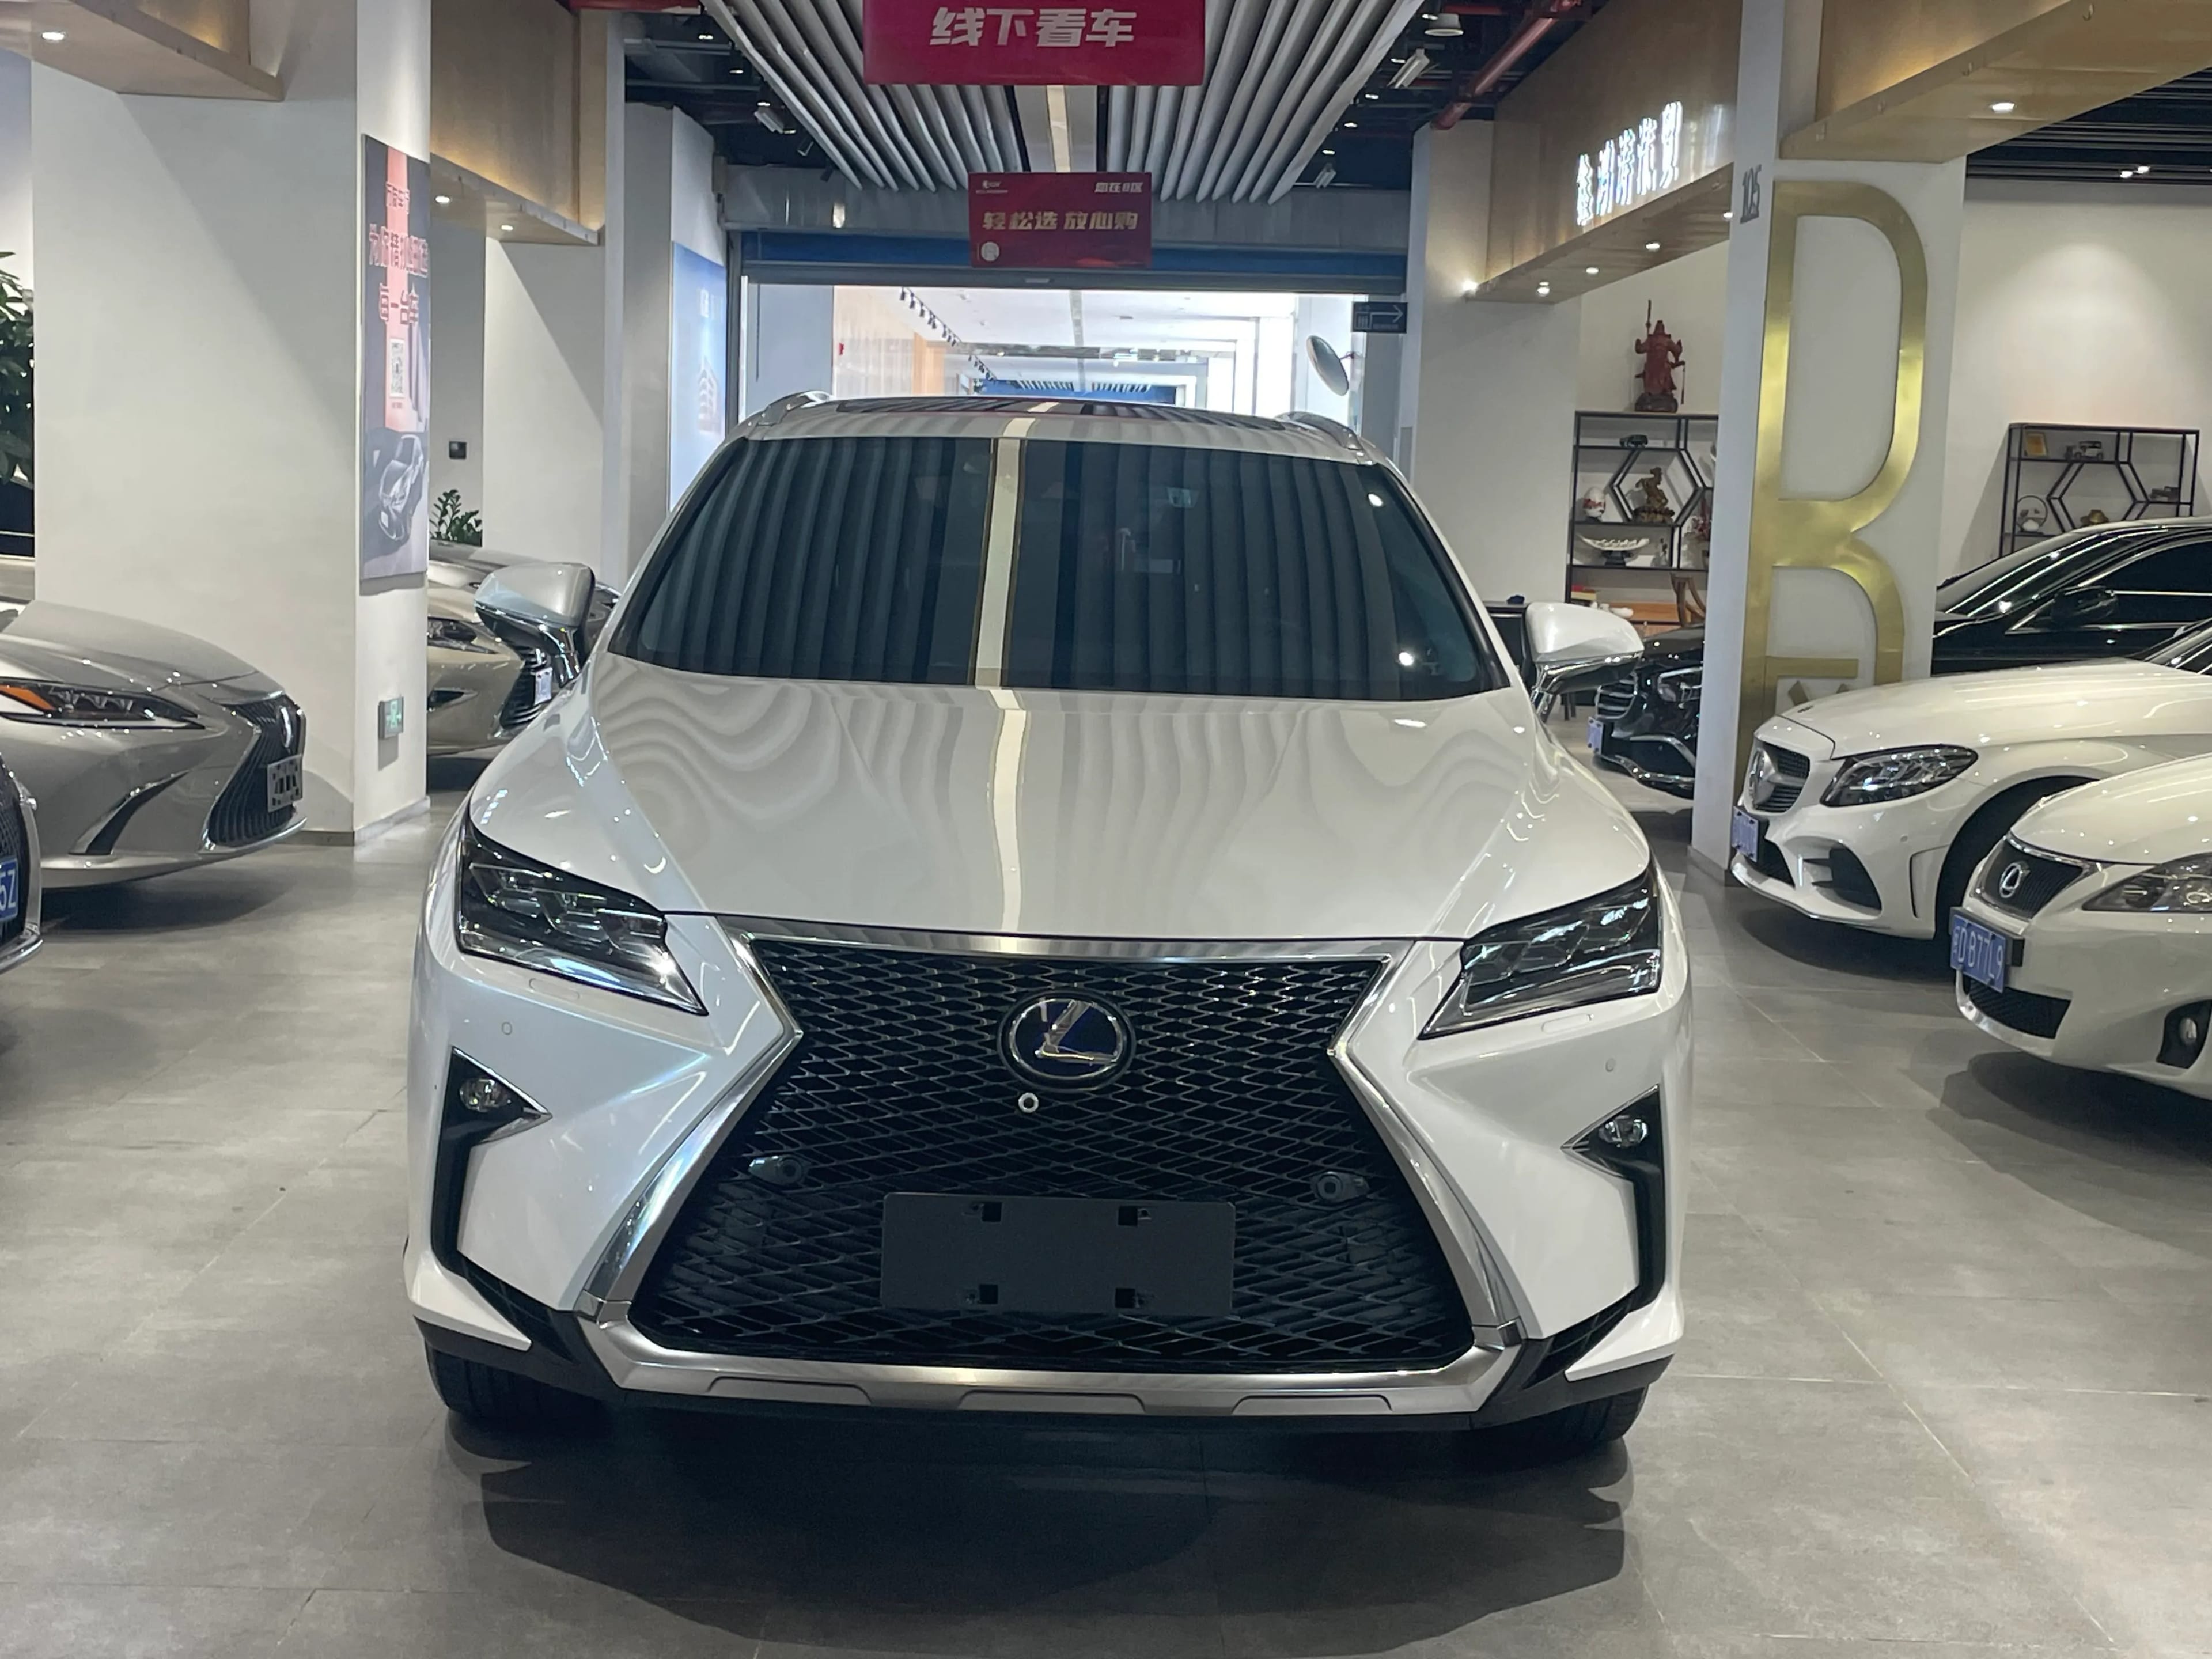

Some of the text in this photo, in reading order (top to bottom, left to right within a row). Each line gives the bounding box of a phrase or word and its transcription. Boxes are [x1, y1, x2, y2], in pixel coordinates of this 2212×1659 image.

[929, 7, 1137, 48] 线下看车
[1740, 164, 1762, 224] 105
[982, 211, 1139, 230] 轻松选 放心购
